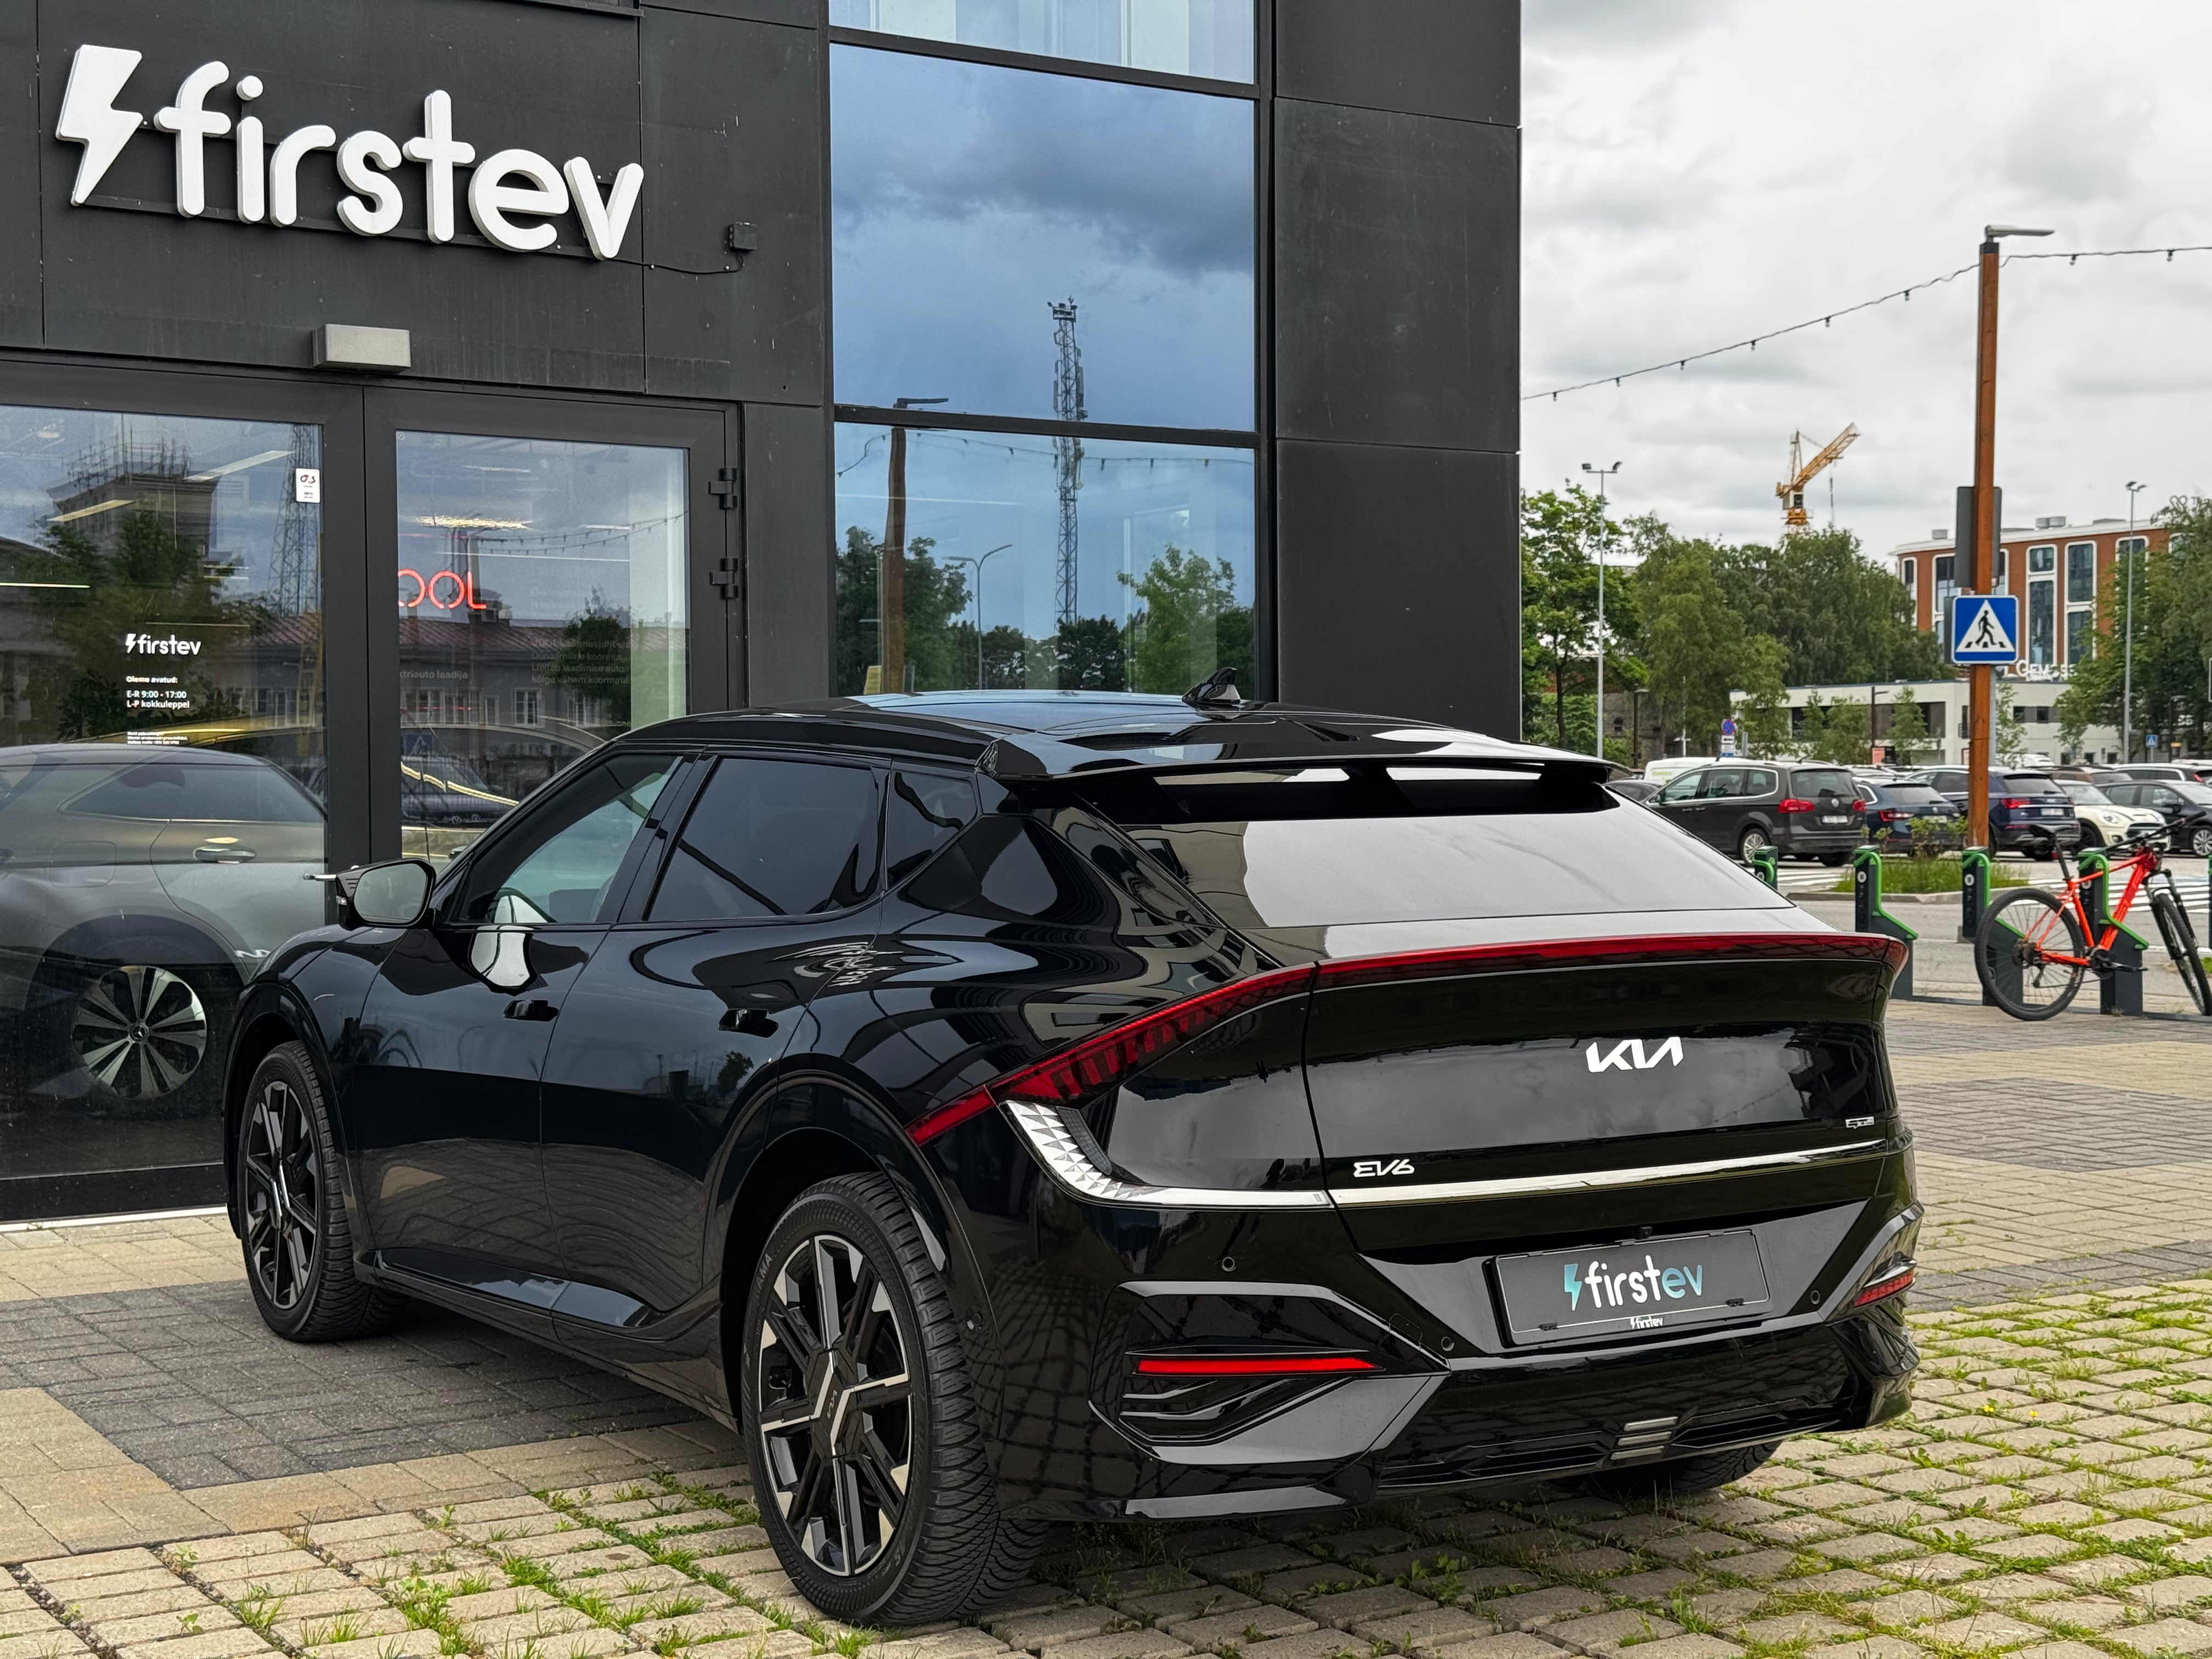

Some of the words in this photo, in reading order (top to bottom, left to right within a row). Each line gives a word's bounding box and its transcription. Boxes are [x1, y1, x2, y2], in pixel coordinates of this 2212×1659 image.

[153, 61, 644, 260] firstev
[137, 634, 201, 655] firstev
[142, 700, 190, 710] kokkuleppel
[1586, 1037, 1684, 1073] KIA
[1353, 1159, 1415, 1177] EV6
[1585, 1255, 1702, 1308] firstev
